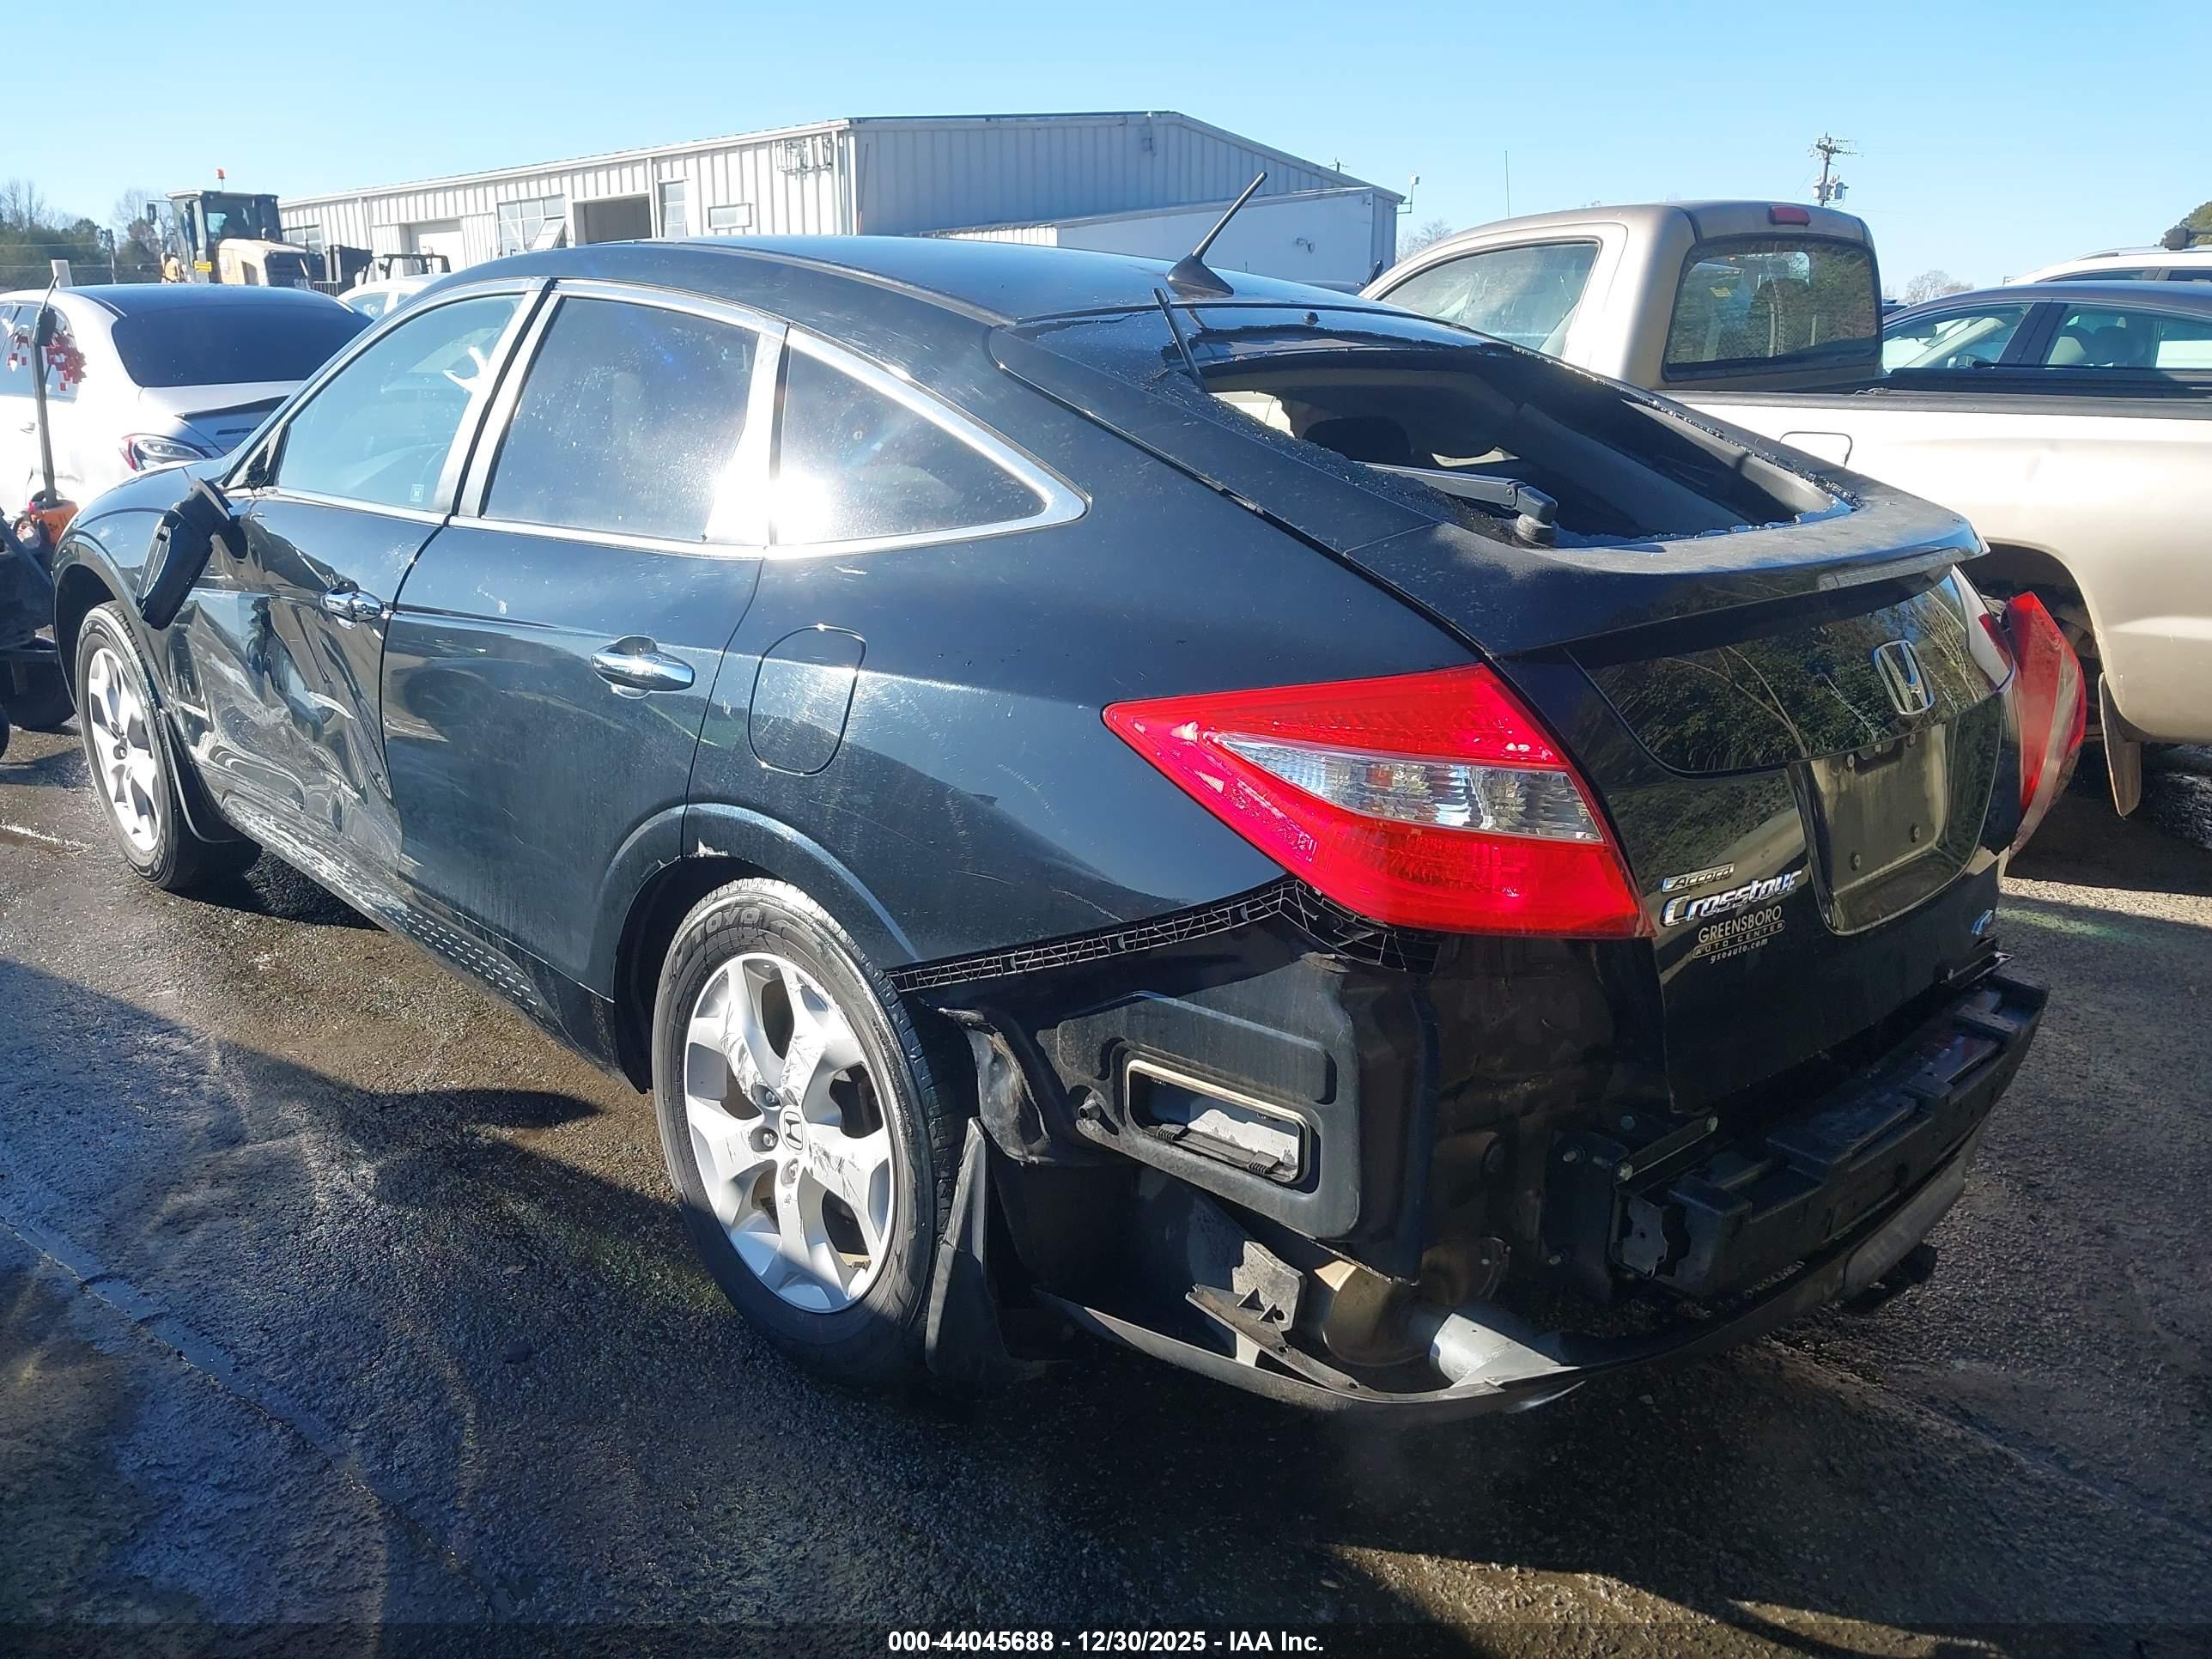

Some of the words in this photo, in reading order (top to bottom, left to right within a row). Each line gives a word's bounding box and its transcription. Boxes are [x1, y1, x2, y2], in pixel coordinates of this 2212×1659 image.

[1669, 866, 1733, 890] Accord
[1661, 870, 1802, 927] Crosstour
[690, 906, 761, 944] TOYO
[1695, 940, 1729, 956] AUTO
[1737, 923, 1783, 942] CENTER
[1698, 905, 1782, 944] GREENSBORO
[1710, 938, 1768, 963] gsoauto.com
